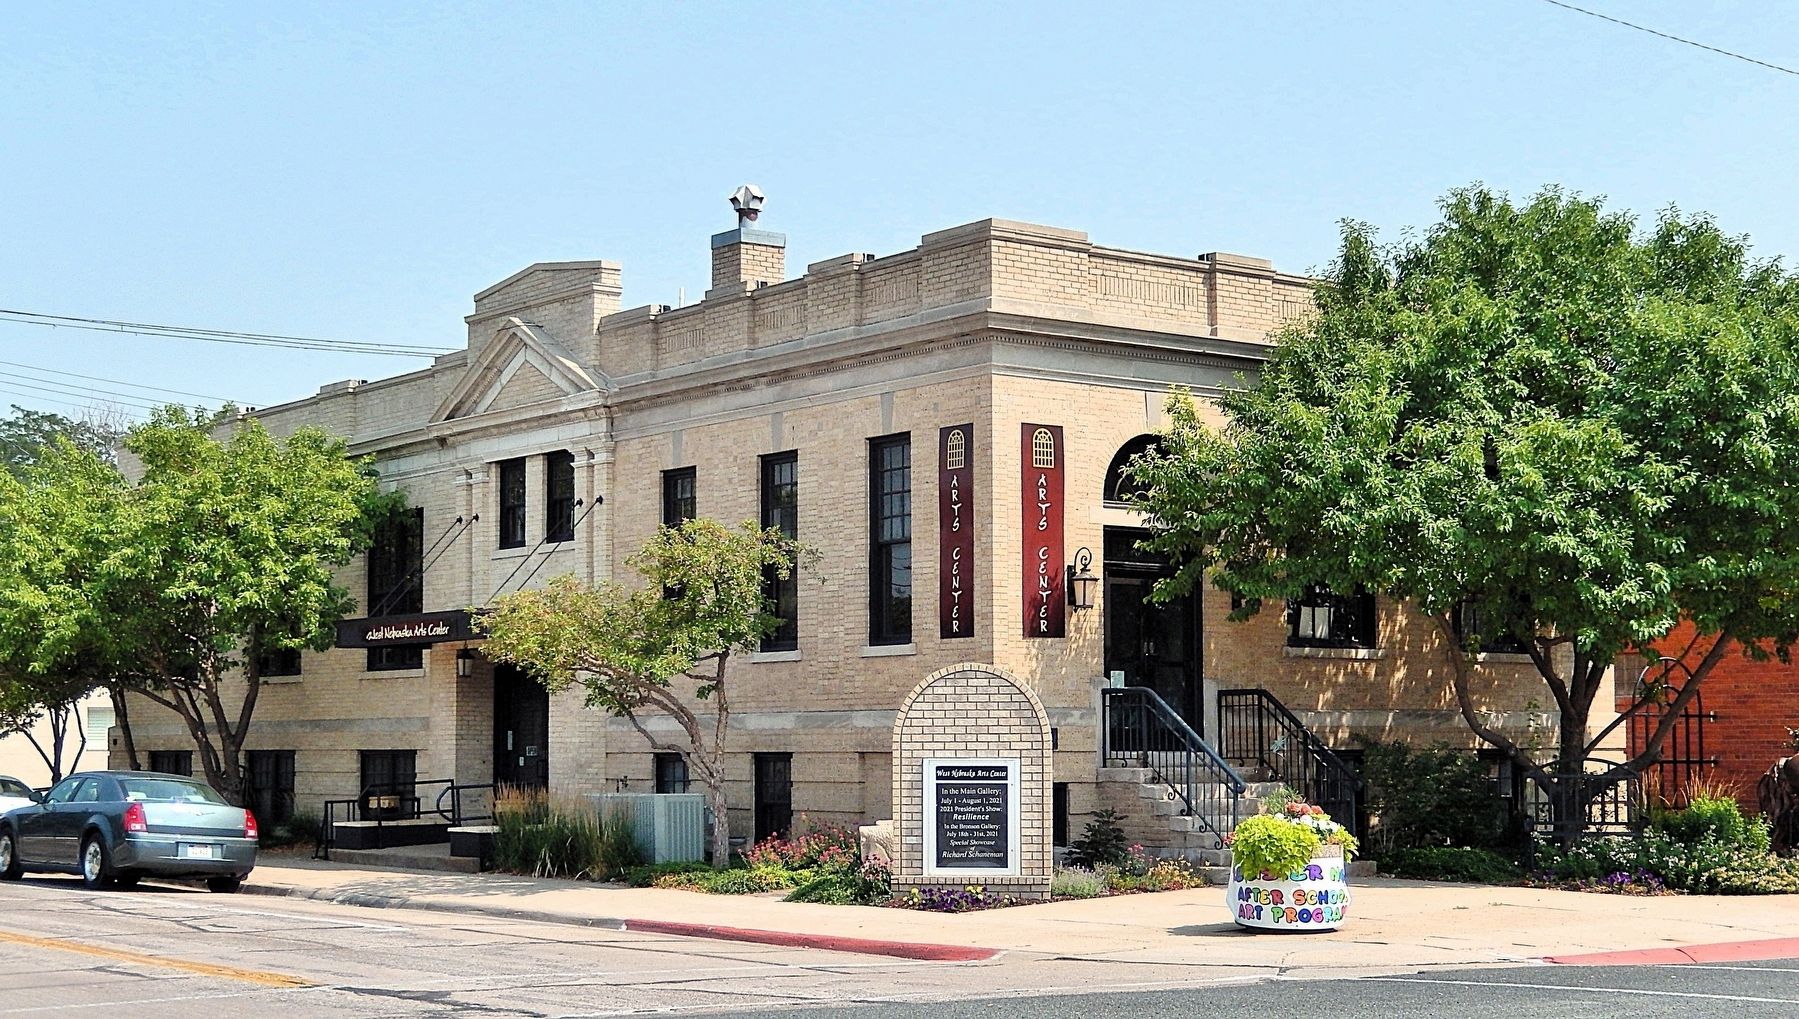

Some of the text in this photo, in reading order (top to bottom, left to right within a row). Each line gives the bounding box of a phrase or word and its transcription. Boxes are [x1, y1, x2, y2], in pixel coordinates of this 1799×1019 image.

[951, 475, 962, 633] ARTS CENTER
[1038, 474, 1051, 632] ARTS CENTER
[366, 621, 449, 640] West Nebraska Arts Center
[952, 769, 975, 777] Nebraska
[1237, 886, 1284, 905] AFTER
[1237, 904, 1264, 920] ART
